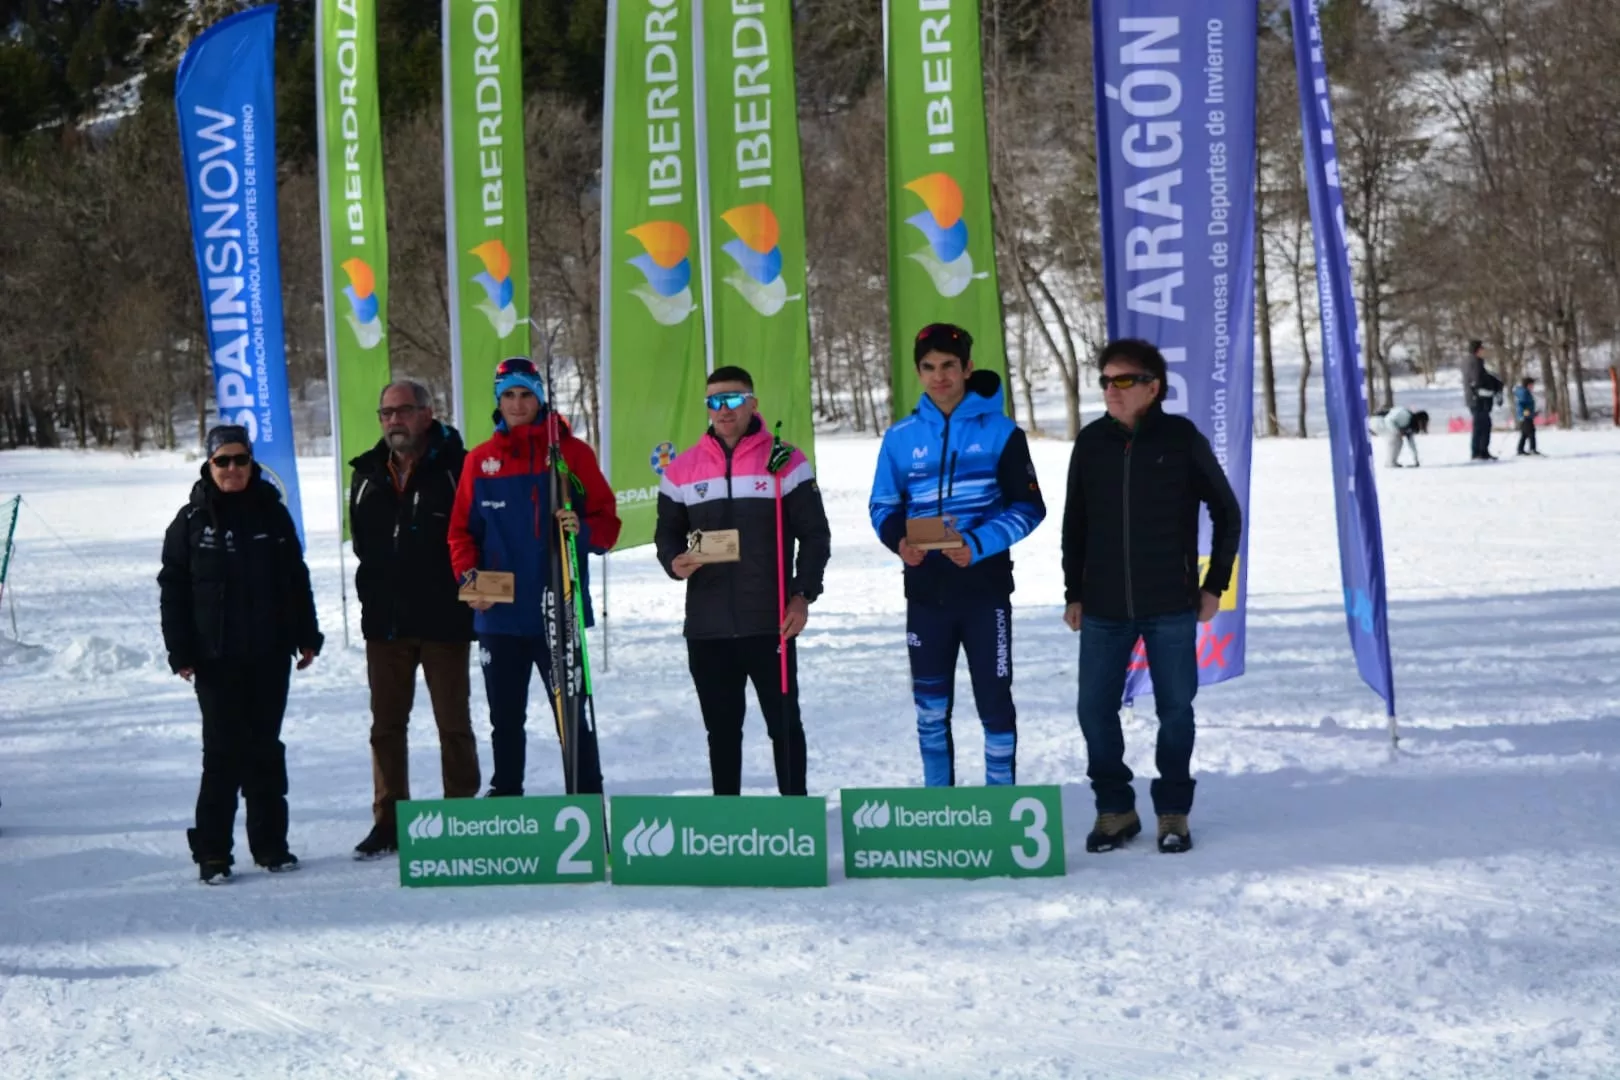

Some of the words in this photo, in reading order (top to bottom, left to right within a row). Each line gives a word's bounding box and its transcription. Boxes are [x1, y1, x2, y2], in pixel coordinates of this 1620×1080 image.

[1203, 18, 1224, 104] Invierno
[242, 104, 256, 166] INVIERNO
[472, 0, 504, 226] IBERDRO
[644, 0, 682, 206] IBERDR
[1204, 110, 1226, 136] de
[243, 167, 256, 186] DE
[1104, 16, 1185, 321] ARAGÓN
[1207, 140, 1231, 236] Deportes
[245, 188, 259, 255] DEPORTES
[1208, 241, 1228, 268] de
[248, 256, 263, 325] ESPAÑOLA
[1211, 273, 1231, 382] Aragonesa
[252, 326, 270, 408] FEDERACIÓN
[261, 409, 273, 443] REAL
[1211, 388, 1228, 475] eración
[995, 608, 1008, 677] SPAINSNOW
[448, 814, 539, 837] Iberdrola
[554, 805, 593, 874] 2
[682, 827, 815, 856] Iberdrola
[895, 805, 992, 827] Iberdrola
[1009, 797, 1051, 869] 3
[409, 857, 540, 878] SPAINSNOW
[854, 849, 993, 869] SPAINSNOW
